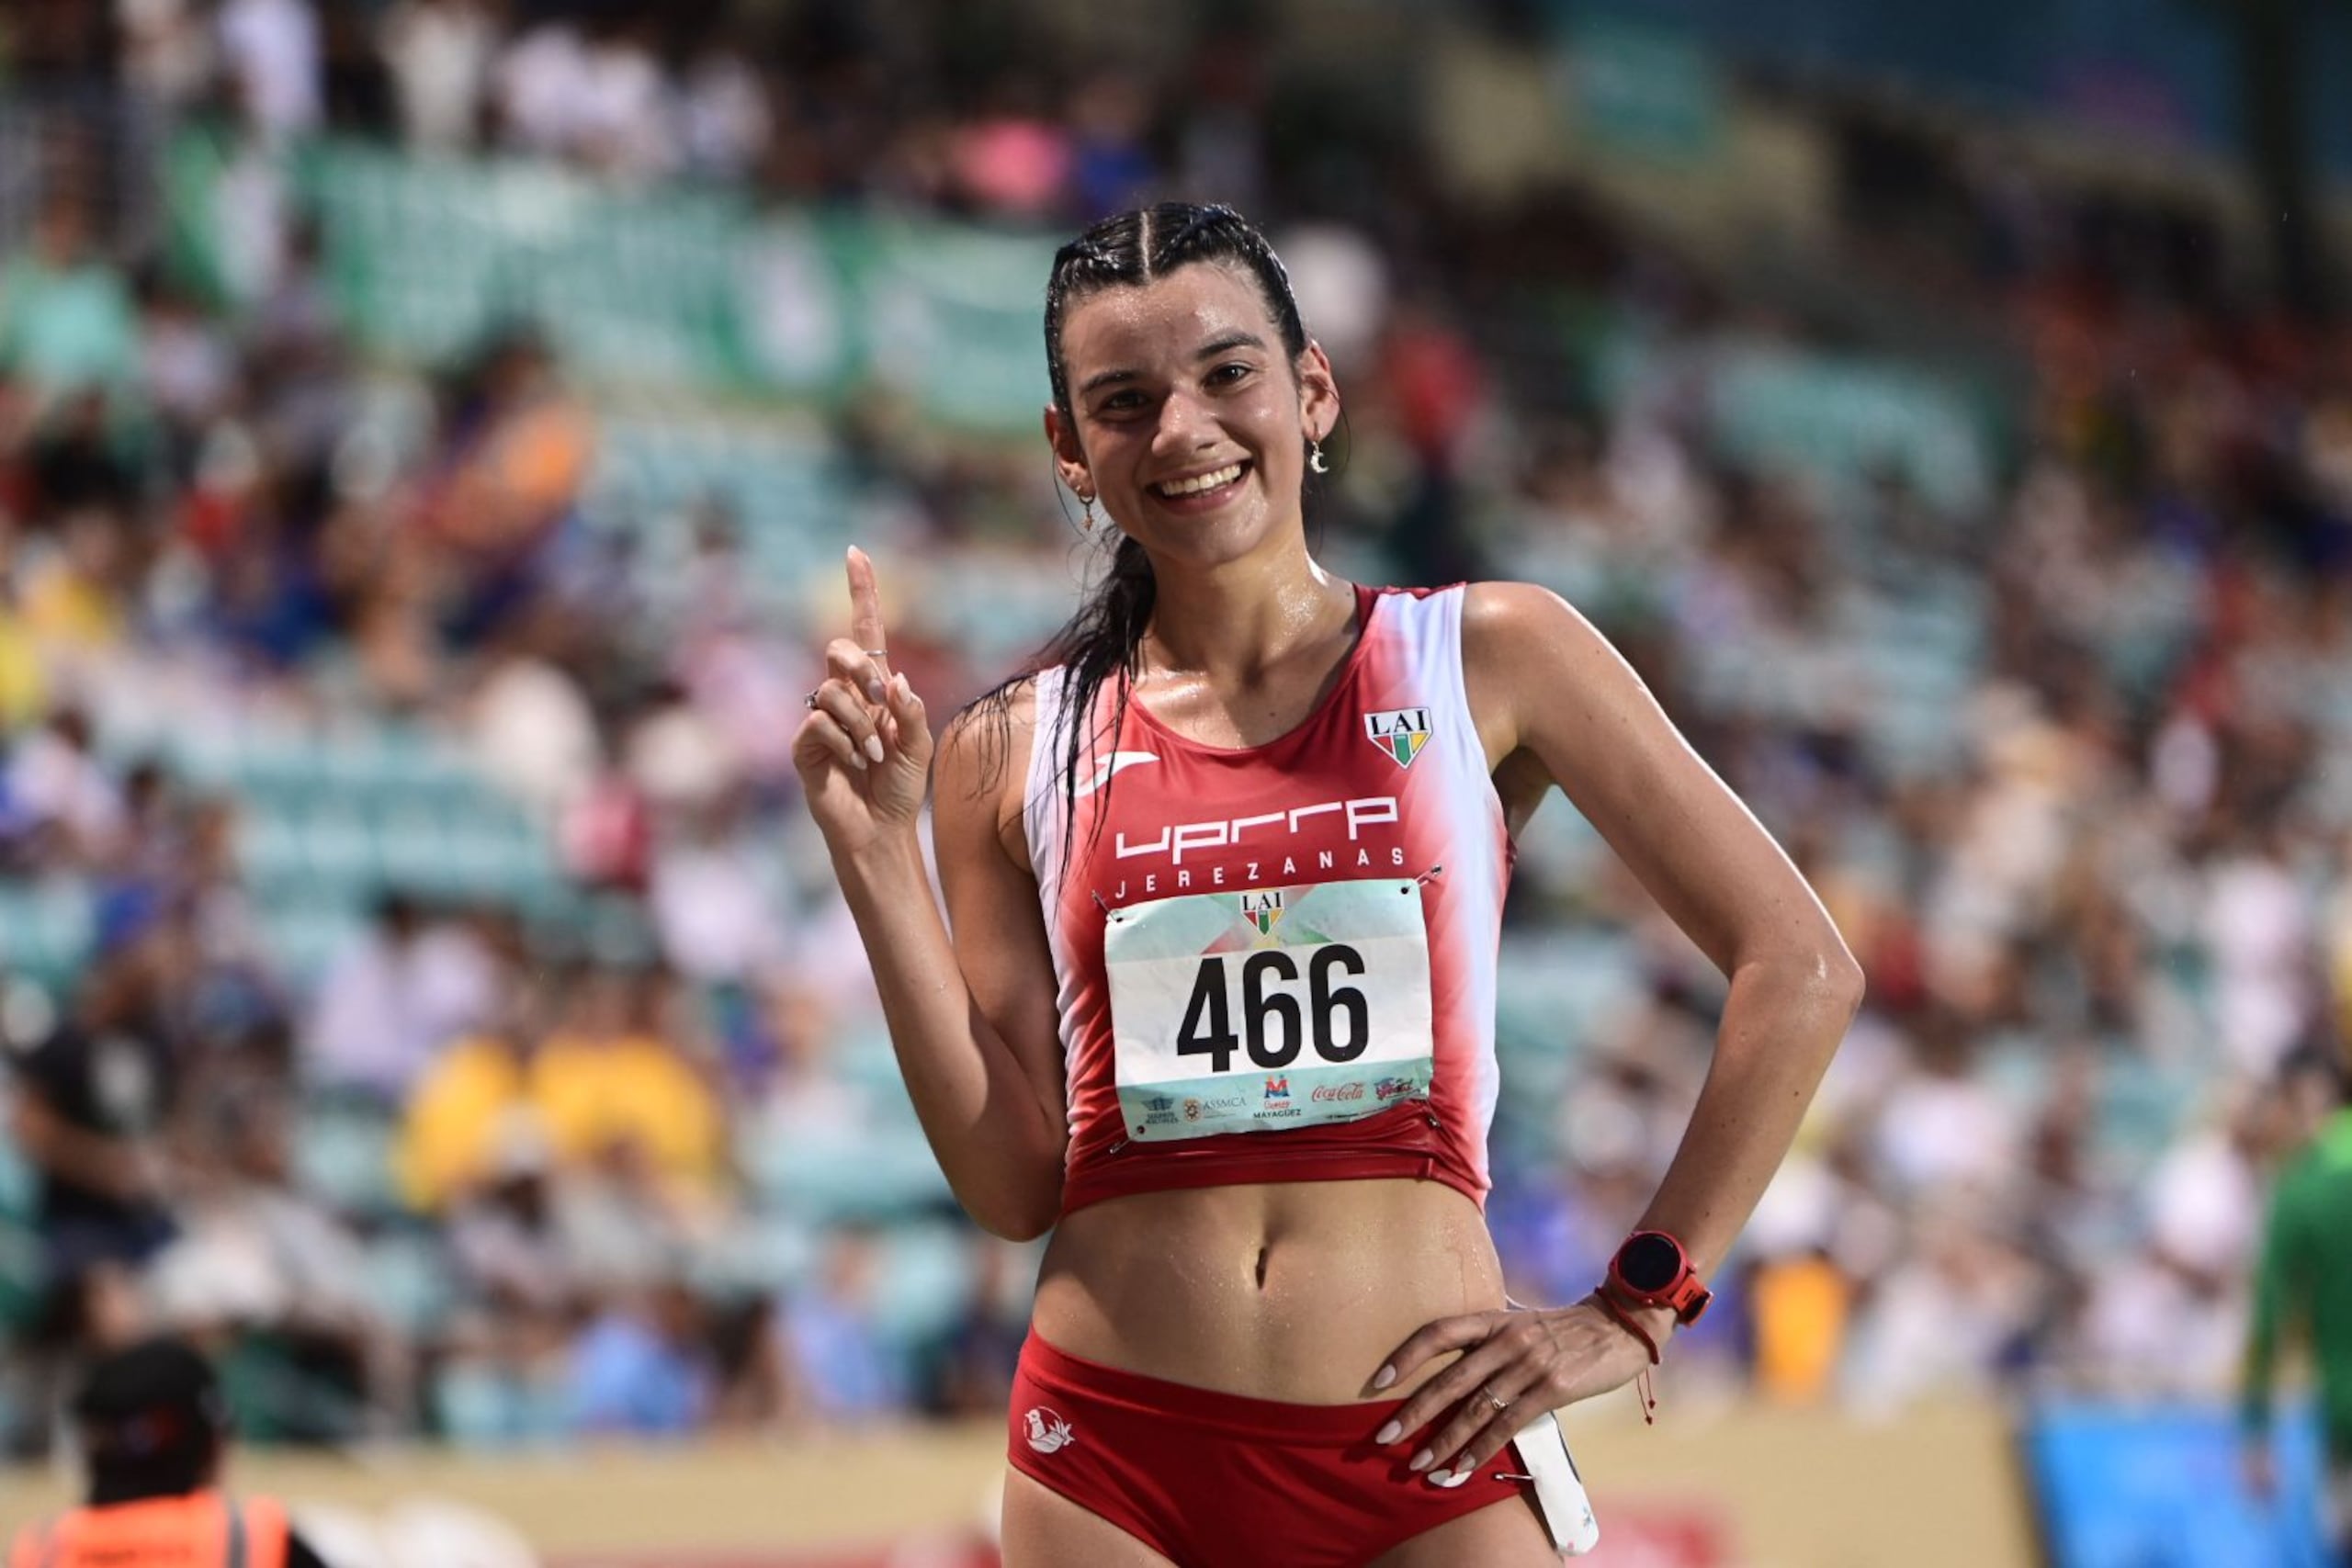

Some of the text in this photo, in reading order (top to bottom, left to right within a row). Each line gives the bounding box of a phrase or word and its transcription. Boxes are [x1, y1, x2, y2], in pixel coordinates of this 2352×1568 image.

[1370, 709, 1427, 735] LAI
[1114, 847, 1404, 899] JEREZANAS
[1242, 892, 1282, 910] LAI
[1176, 943, 1370, 1073] 466
